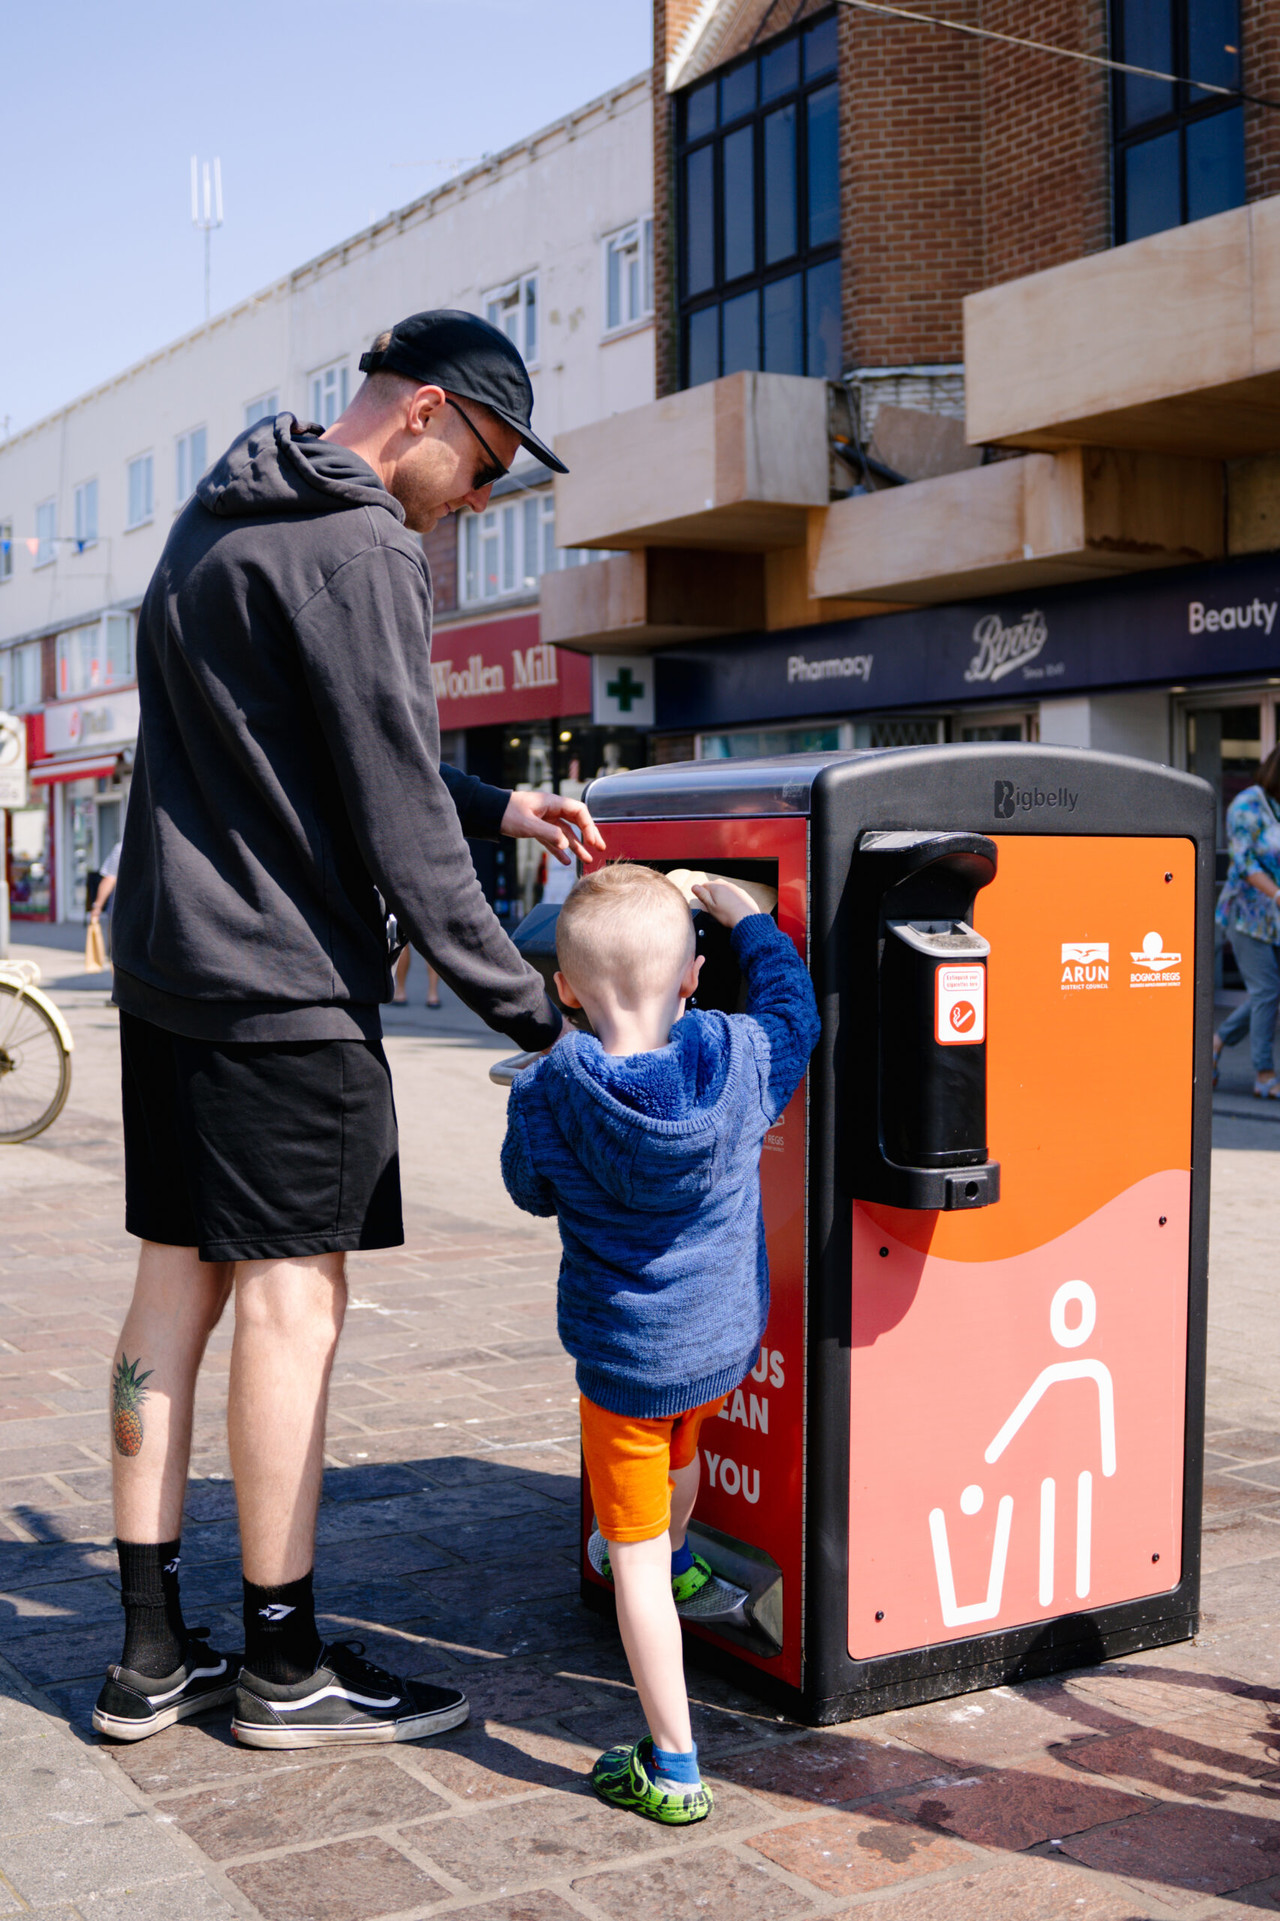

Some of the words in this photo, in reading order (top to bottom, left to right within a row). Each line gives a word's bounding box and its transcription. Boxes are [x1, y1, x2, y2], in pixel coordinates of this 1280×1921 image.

[1189, 598, 1278, 635] Beauty
[963, 609, 1049, 682] Boots
[512, 643, 559, 690] Mill
[787, 654, 874, 683] Pharmacy
[994, 780, 1079, 819] Bigbelly
[1061, 965, 1110, 983] ARUN
[1130, 972, 1161, 983] BOGNOR
[1162, 971, 1182, 982] REGIS
[750, 1346, 785, 1389] US
[703, 1449, 760, 1504] YOU
